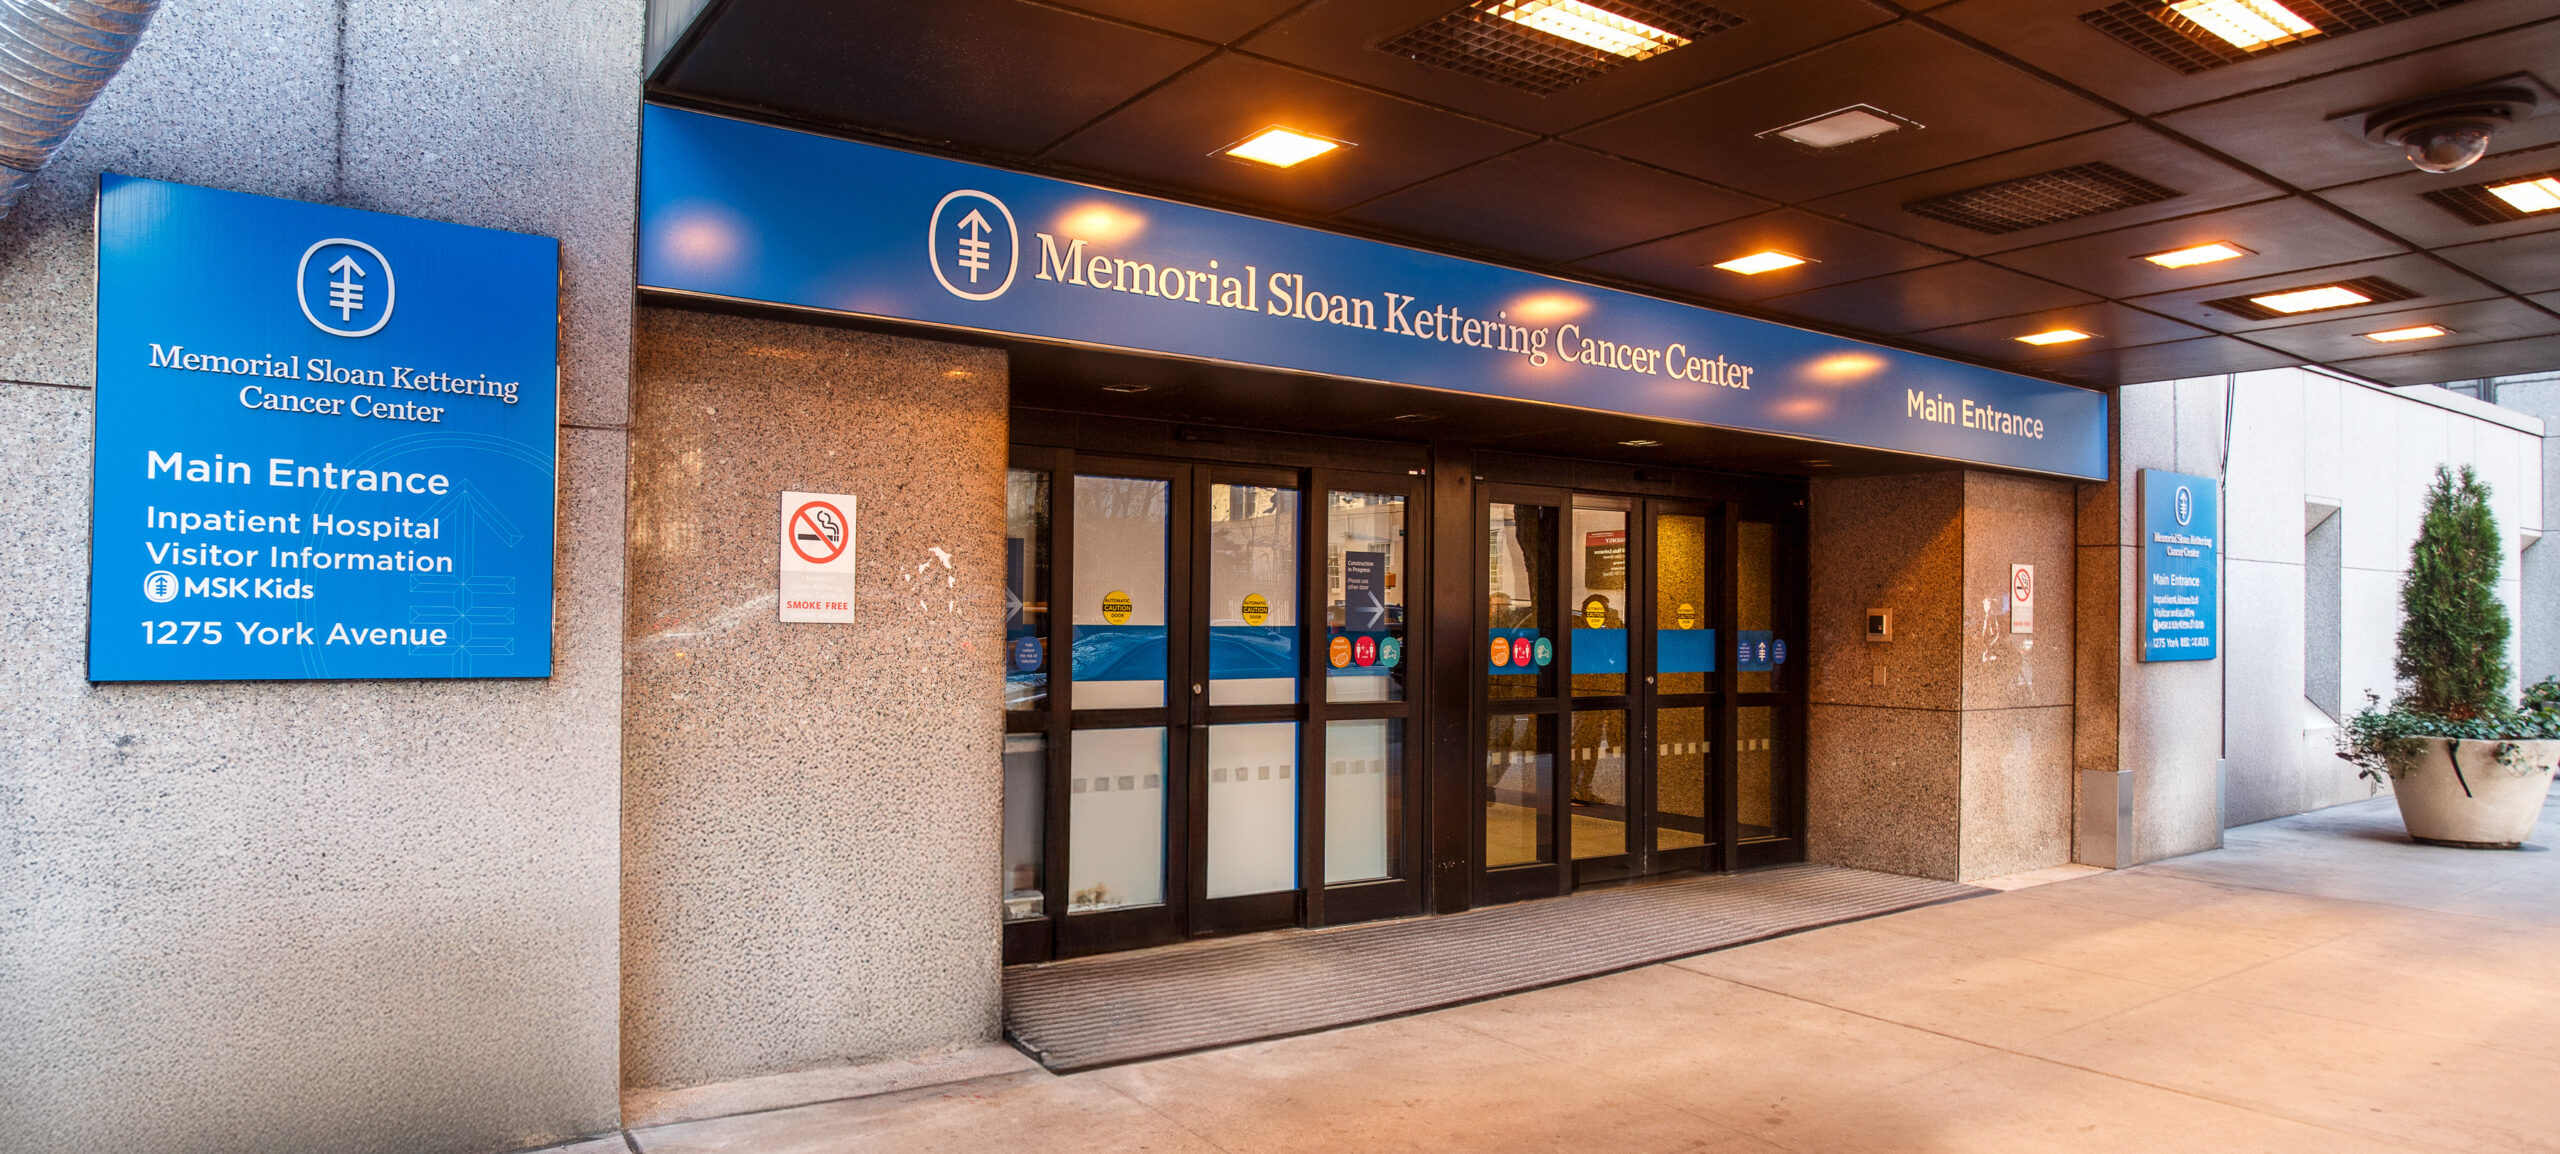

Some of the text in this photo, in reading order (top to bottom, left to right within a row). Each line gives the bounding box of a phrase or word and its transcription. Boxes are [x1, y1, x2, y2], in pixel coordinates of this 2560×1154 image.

[1034, 231, 1755, 391] Memorial Sloan Kettering Cancer Center
[147, 342, 520, 404] Memorial Sloan Kettering
[238, 384, 446, 423] Cancer Center
[1907, 388, 2044, 440] Main Entrance
[147, 450, 451, 496] Main Entrance
[146, 505, 441, 542] Inpatient Hospital
[144, 541, 454, 573] Visitor Information
[183, 576, 315, 600] MSK Kids
[2153, 573, 2200, 587] Main Entrance
[786, 601, 848, 610] SMOKE FREE
[141, 620, 449, 647] 1275 York Avenue
[2152, 637, 2166, 648] 1275
[2166, 637, 2180, 648] York
